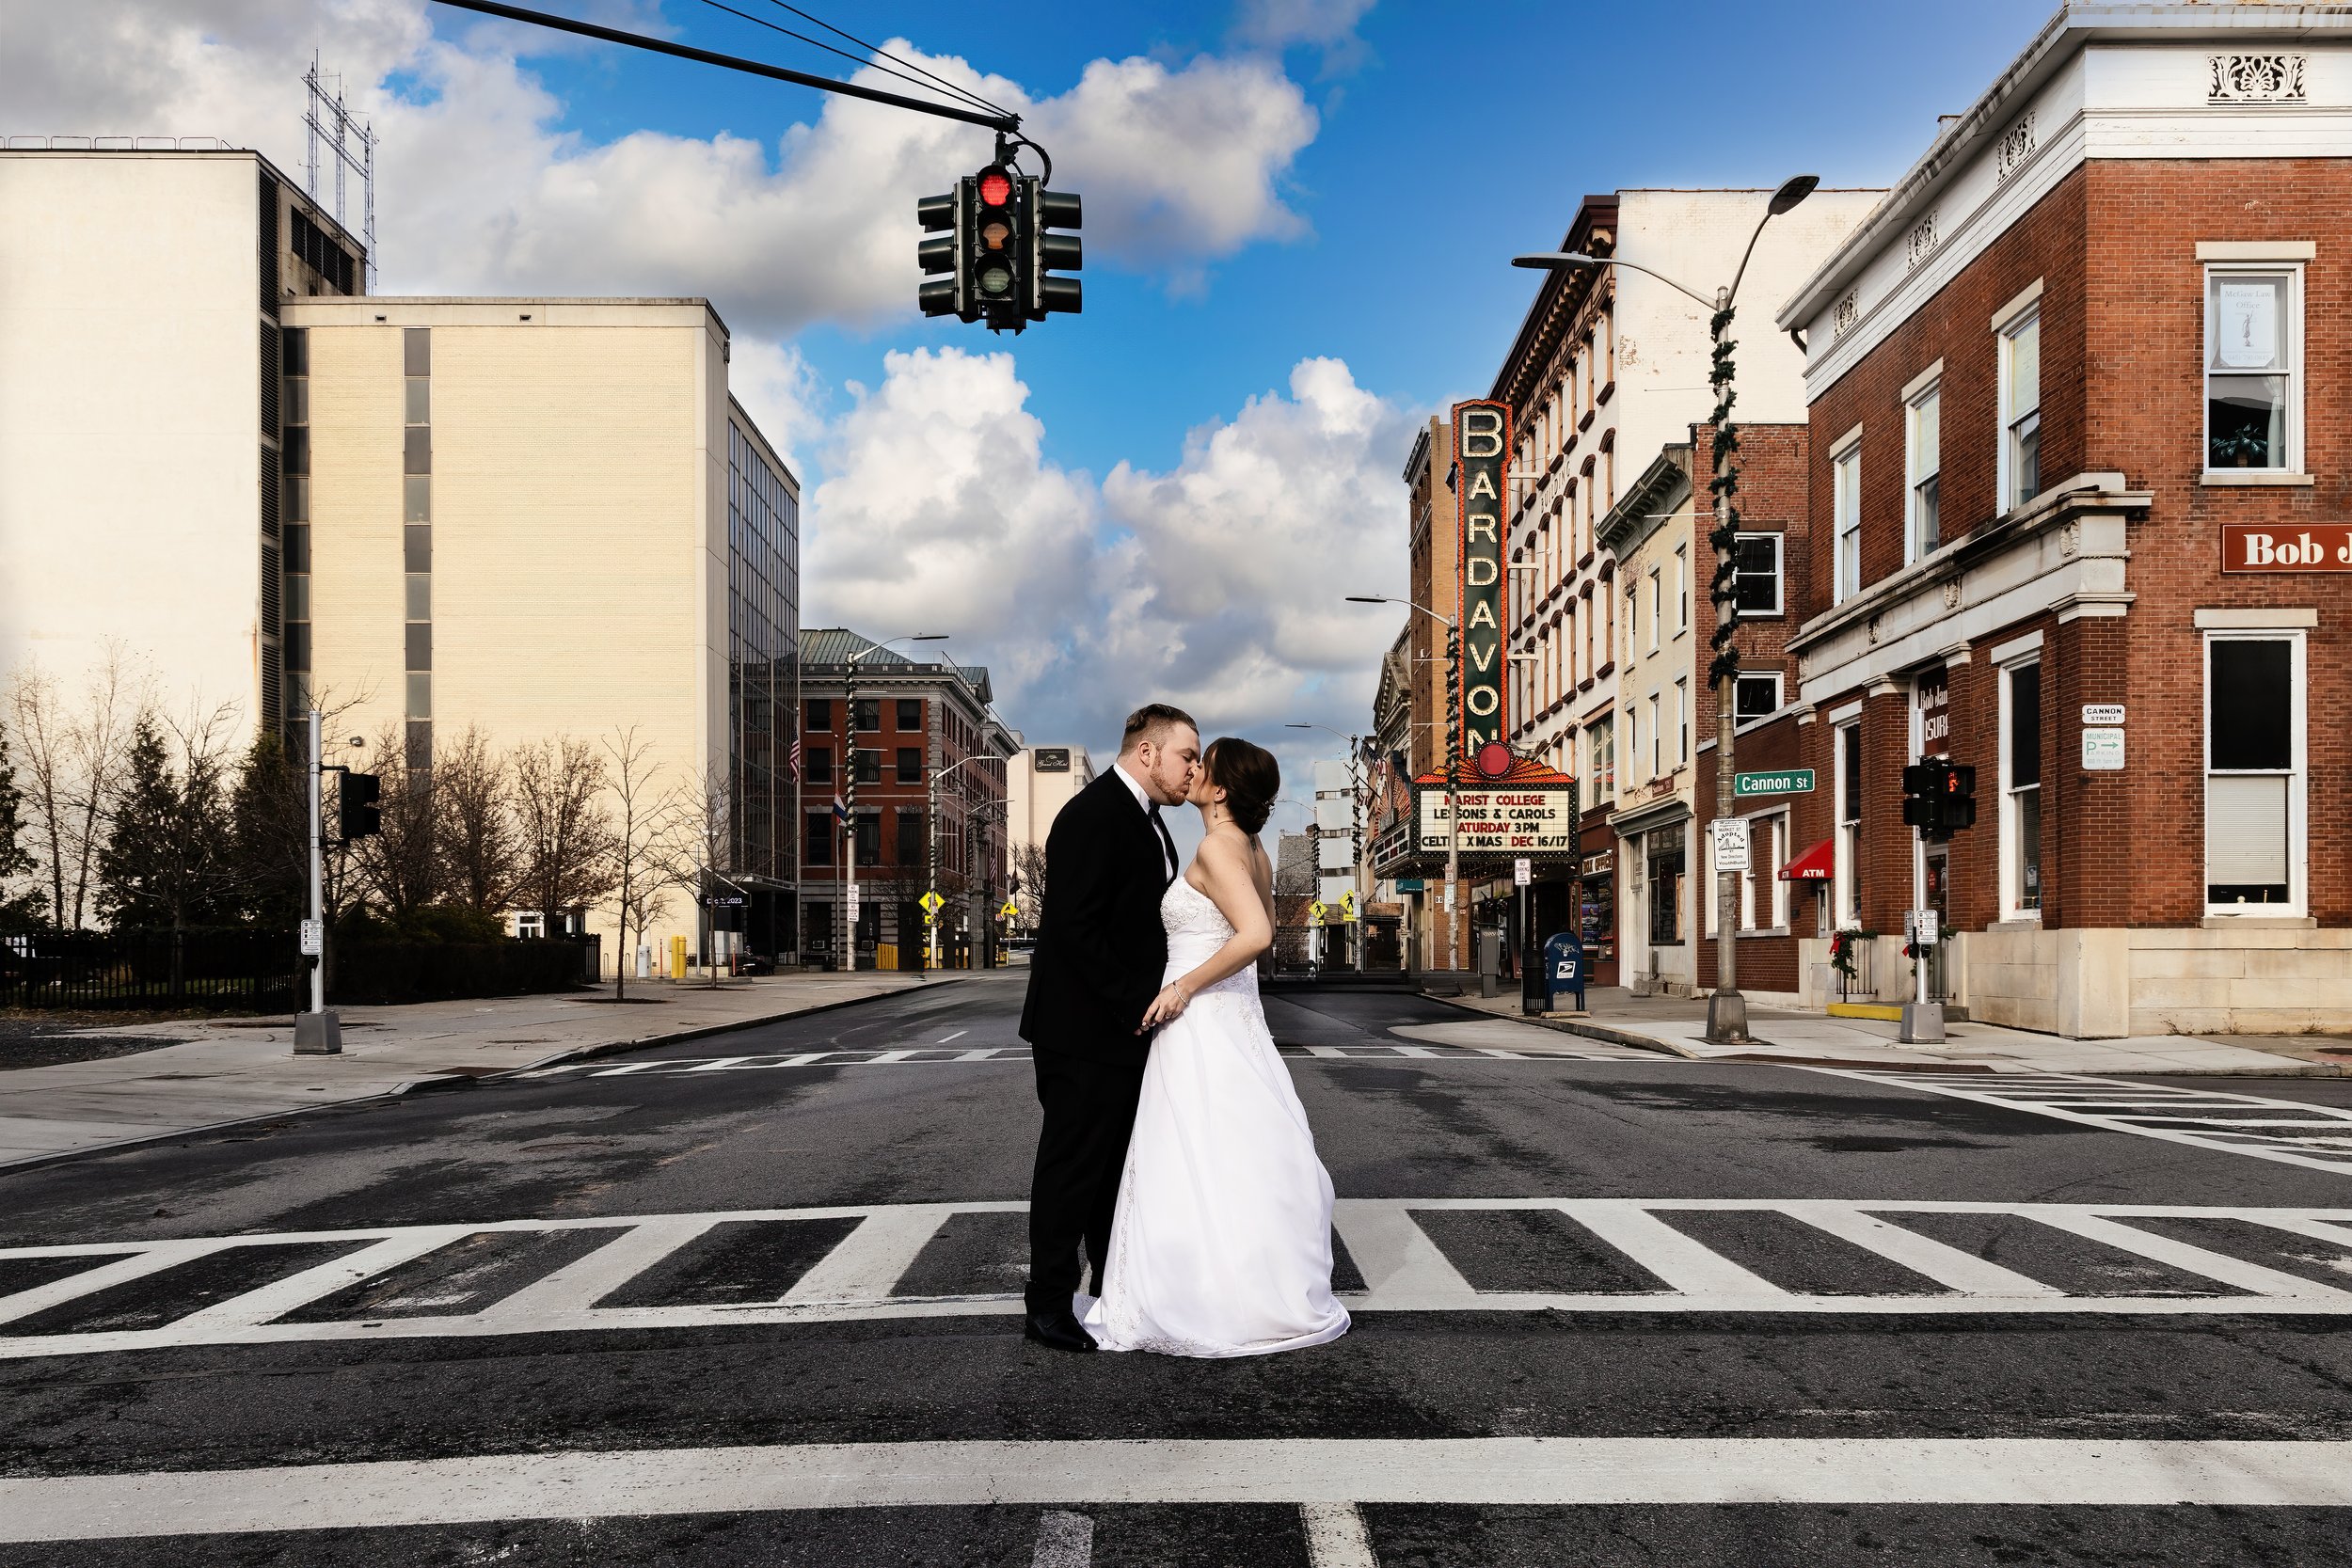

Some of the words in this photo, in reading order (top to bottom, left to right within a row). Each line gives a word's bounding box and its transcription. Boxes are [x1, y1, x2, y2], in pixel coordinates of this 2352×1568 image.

[2235, 301, 2261, 309] Office
[2243, 531, 2325, 565] Bob
[1462, 410, 1503, 758] BARDAVON
[1920, 687, 1934, 711] Bob
[1036, 759, 1052, 768] Grand
[1741, 776, 1791, 792] Cannon
[1796, 777, 1808, 788] St
[1496, 795, 1546, 806] COLLEGE
[1434, 808, 1486, 819] LESONS
[1493, 808, 1502, 819] &
[1508, 808, 1556, 819] CAROLS
[1457, 822, 1511, 833] ATURDAY
[1511, 835, 1534, 847] DEC
[1537, 835, 1568, 847] 16/17
[1717, 832, 1745, 843] Adopted
[1802, 869, 1825, 878] ATM
